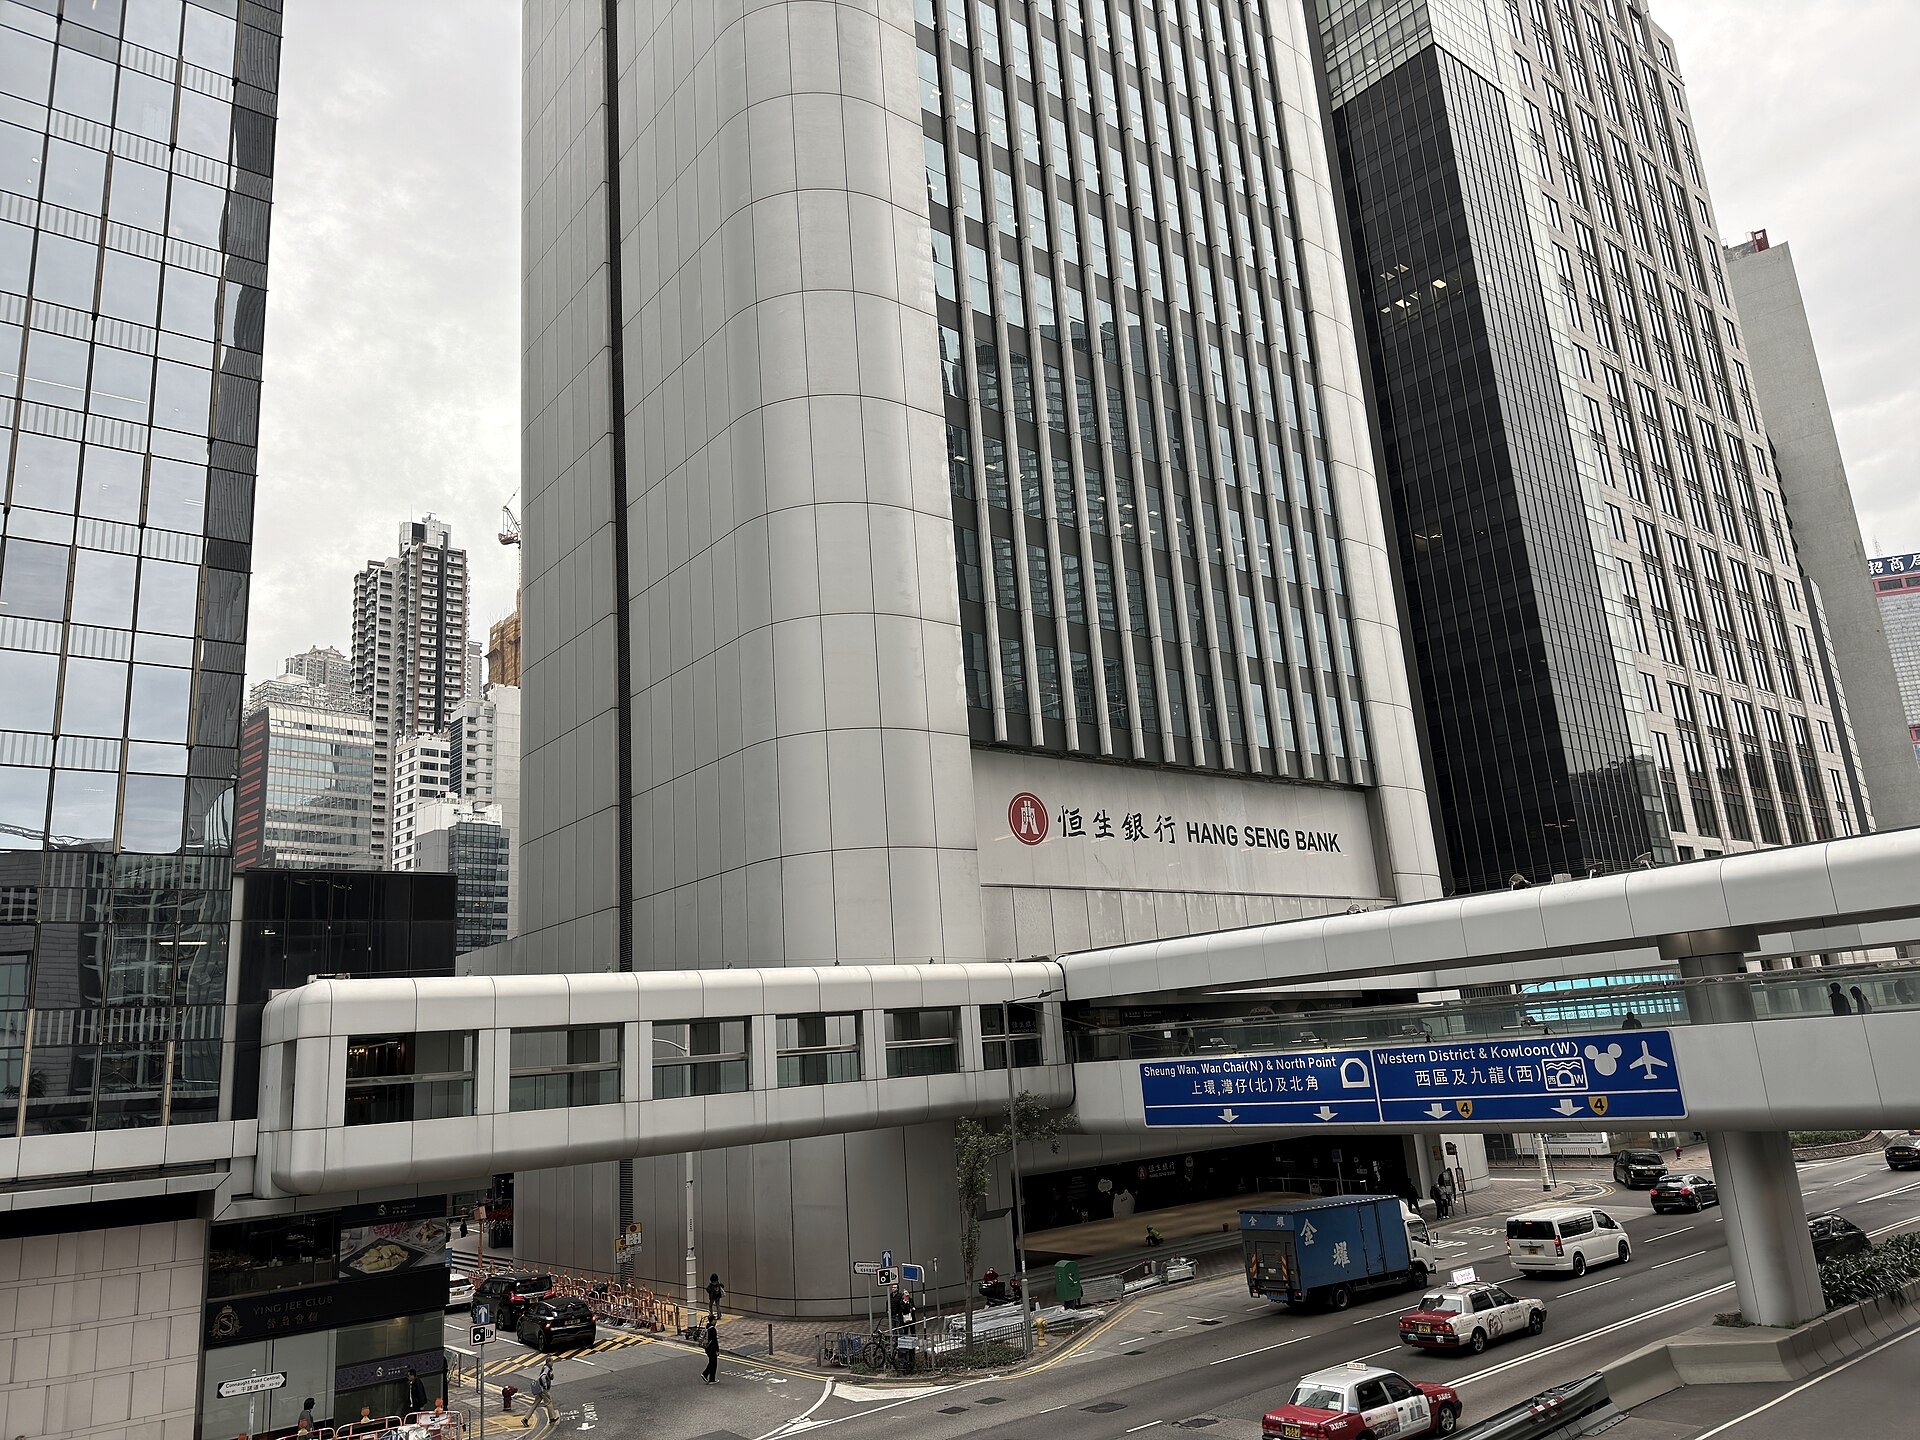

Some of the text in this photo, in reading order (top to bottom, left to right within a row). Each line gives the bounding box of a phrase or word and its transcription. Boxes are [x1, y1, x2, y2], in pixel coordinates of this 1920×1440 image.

[1057, 804, 1176, 844] 恒生銀行
[1186, 821, 1341, 852] HANG SENG BANK
[1377, 1041, 1579, 1065] Western District & Kowloon(W)
[1144, 1066, 1176, 1077] Sheung
[1201, 1063, 1221, 1074] Wan
[1223, 1060, 1264, 1074] Chai(N)
[1266, 1059, 1274, 1070] &
[1276, 1057, 1306, 1070] North
[1308, 1056, 1337, 1069] Point
[1414, 1064, 1542, 1087] 西區及九龍(西)
[1573, 1074, 1584, 1084] W
[1460, 1102, 1471, 1114] 4
[1593, 1098, 1605, 1111] 4
[254, 1303, 282, 1315] YING
[305, 1295, 333, 1307] CLUB
[225, 1380, 250, 1389] Connaught
[263, 1374, 281, 1382] Central
